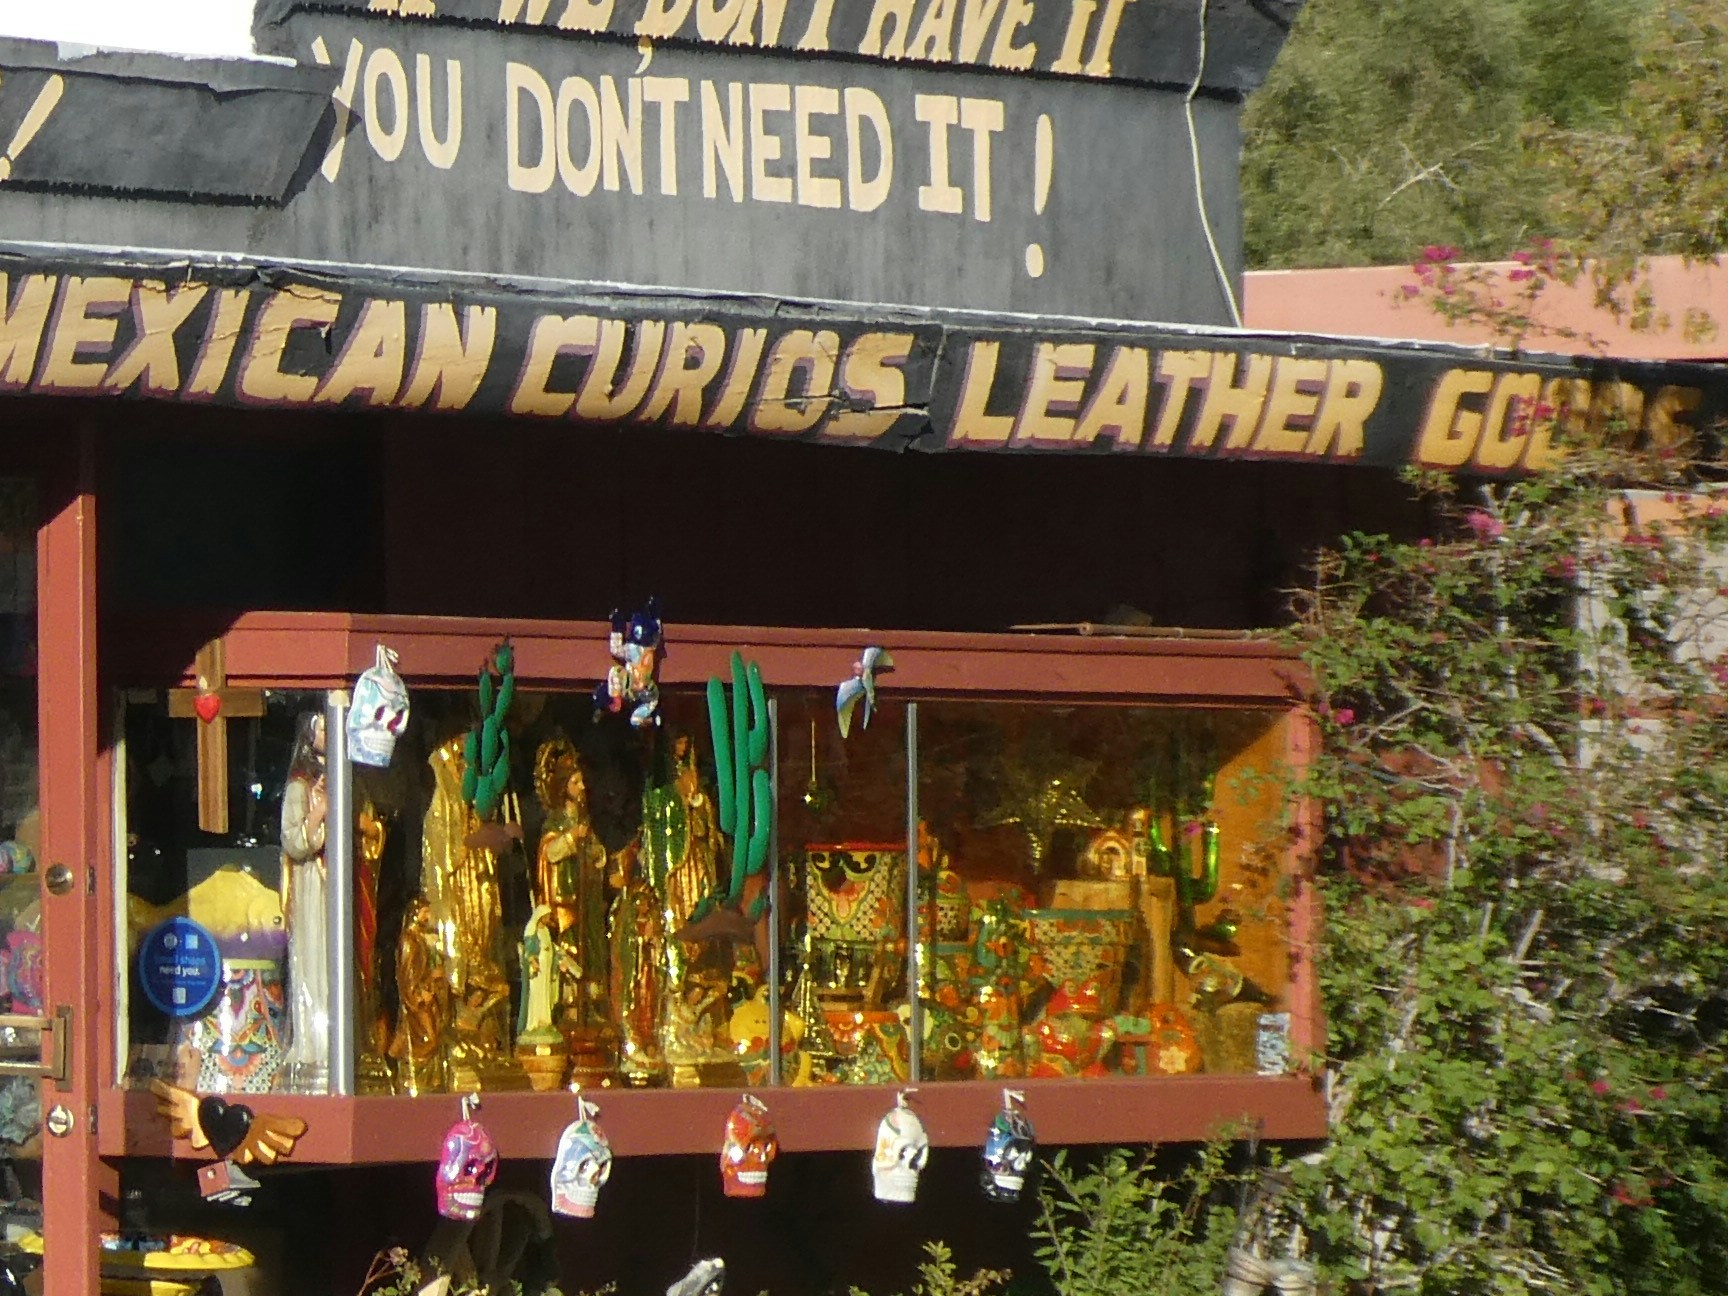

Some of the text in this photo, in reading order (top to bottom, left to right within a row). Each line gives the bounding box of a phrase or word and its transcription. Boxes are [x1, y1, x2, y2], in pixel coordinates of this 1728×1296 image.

[310, 35, 464, 184] YOU
[700, 78, 894, 213] NEED
[510, 315, 919, 448] CURIOS
[947, 339, 1393, 466] LEATHER
